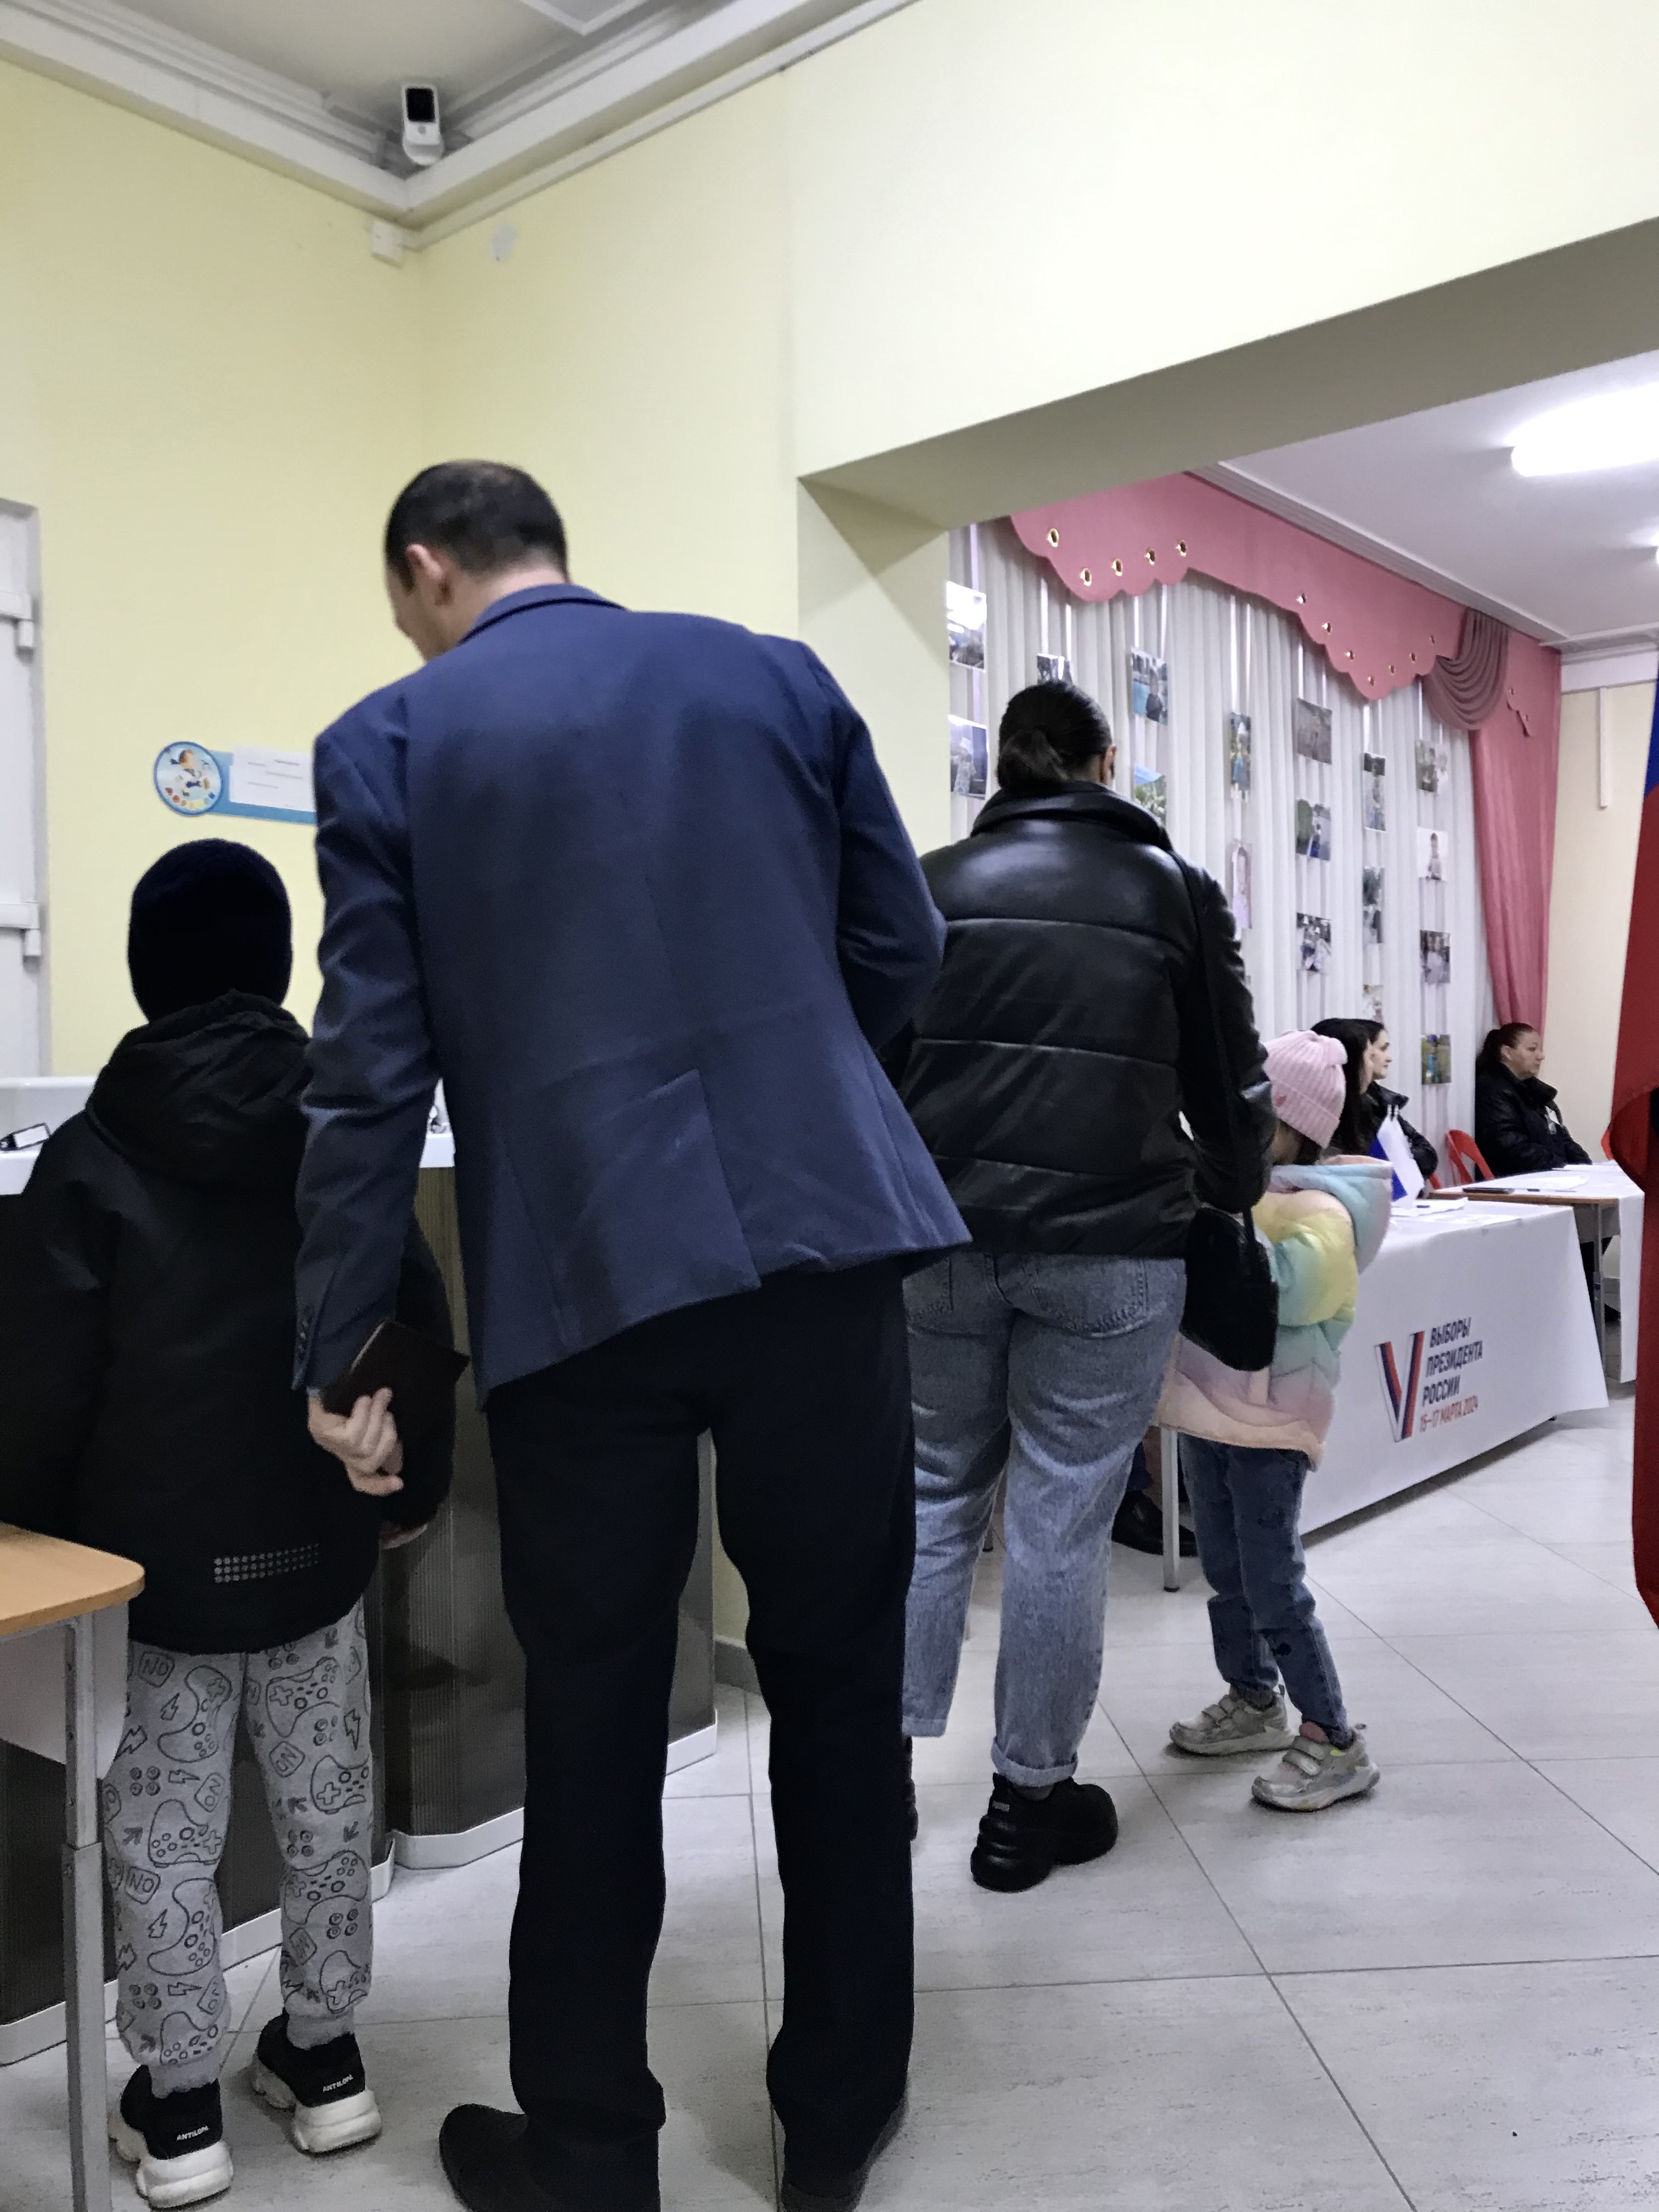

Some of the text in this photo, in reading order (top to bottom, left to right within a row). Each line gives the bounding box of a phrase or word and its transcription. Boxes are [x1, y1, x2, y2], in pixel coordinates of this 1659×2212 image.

[1430, 1317, 1471, 1348] ВЫБОРЫ
[1425, 1340, 1483, 1378] ПРЕЗИДЕНТА
[1422, 1374, 1461, 1407] РОССИИ
